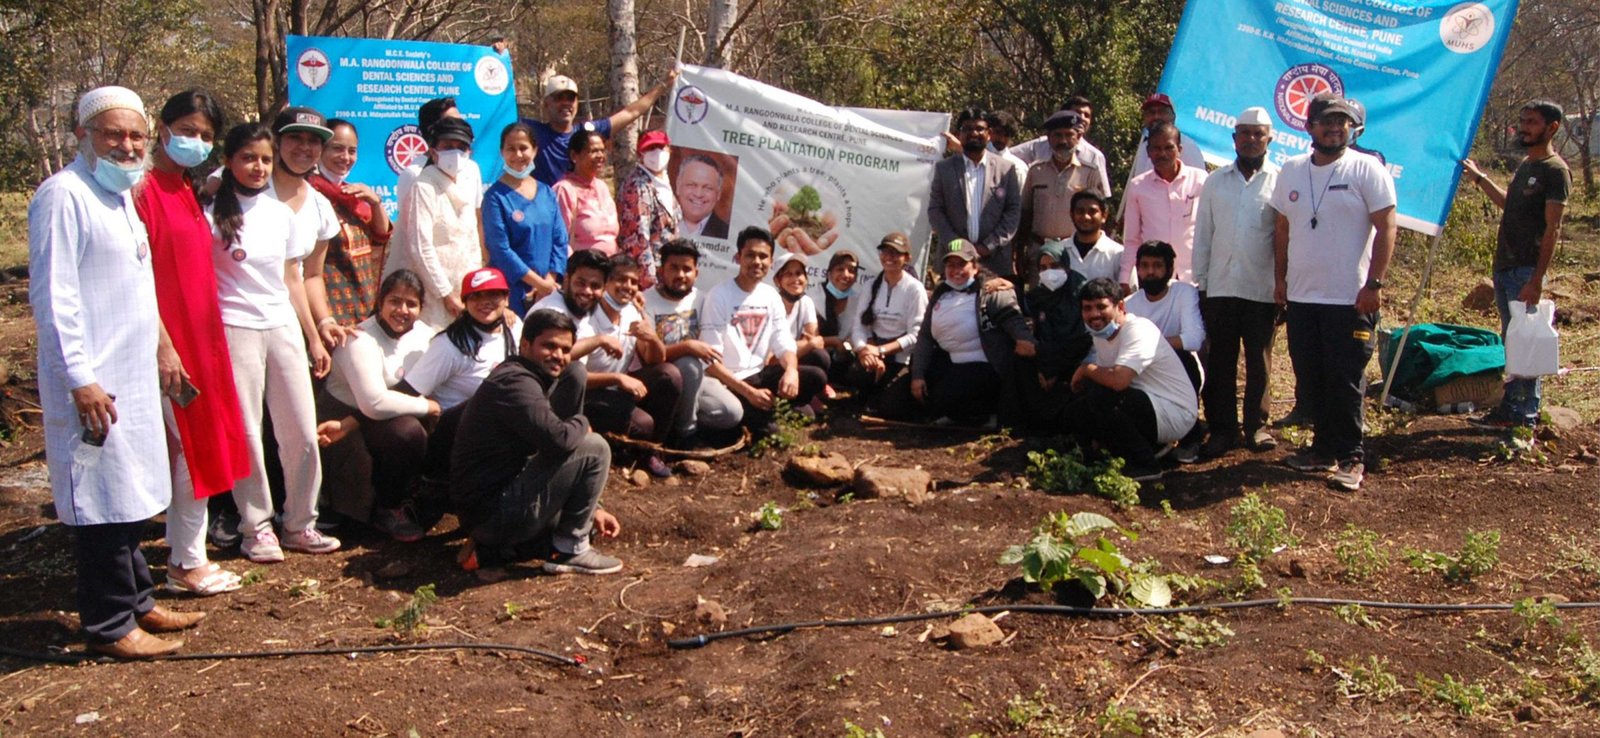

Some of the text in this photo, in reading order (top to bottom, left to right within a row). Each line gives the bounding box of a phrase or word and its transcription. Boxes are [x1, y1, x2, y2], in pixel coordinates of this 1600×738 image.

[1274, 2, 1403, 46] RESEARCH CENTRE, PUNE
[1322, 1, 1373, 22] SCIENCES
[1373, 14, 1398, 28] AND
[1416, 5, 1433, 17] OF
[1446, 39, 1475, 50] MUHS
[340, 57, 472, 72] M.A. RANGOONWALA COLLEGE OF
[363, 71, 454, 83] DENTAL SCIENCES AND
[356, 83, 460, 96] RESEARCH CENTRE, PUNE
[725, 103, 741, 112] M.A.
[743, 106, 800, 123] RANGOONWALA
[801, 115, 832, 129] COLLEGE
[833, 121, 843, 130] OF
[844, 122, 869, 136] DENTAL
[762, 120, 778, 130] AND
[779, 124, 818, 137] RESEARCH
[848, 135, 867, 146] PUNE
[722, 129, 900, 173] TREE PLANTATION PROGRAM
[757, 199, 766, 211] He
[777, 168, 800, 183] plants
[827, 175, 847, 198] plants
